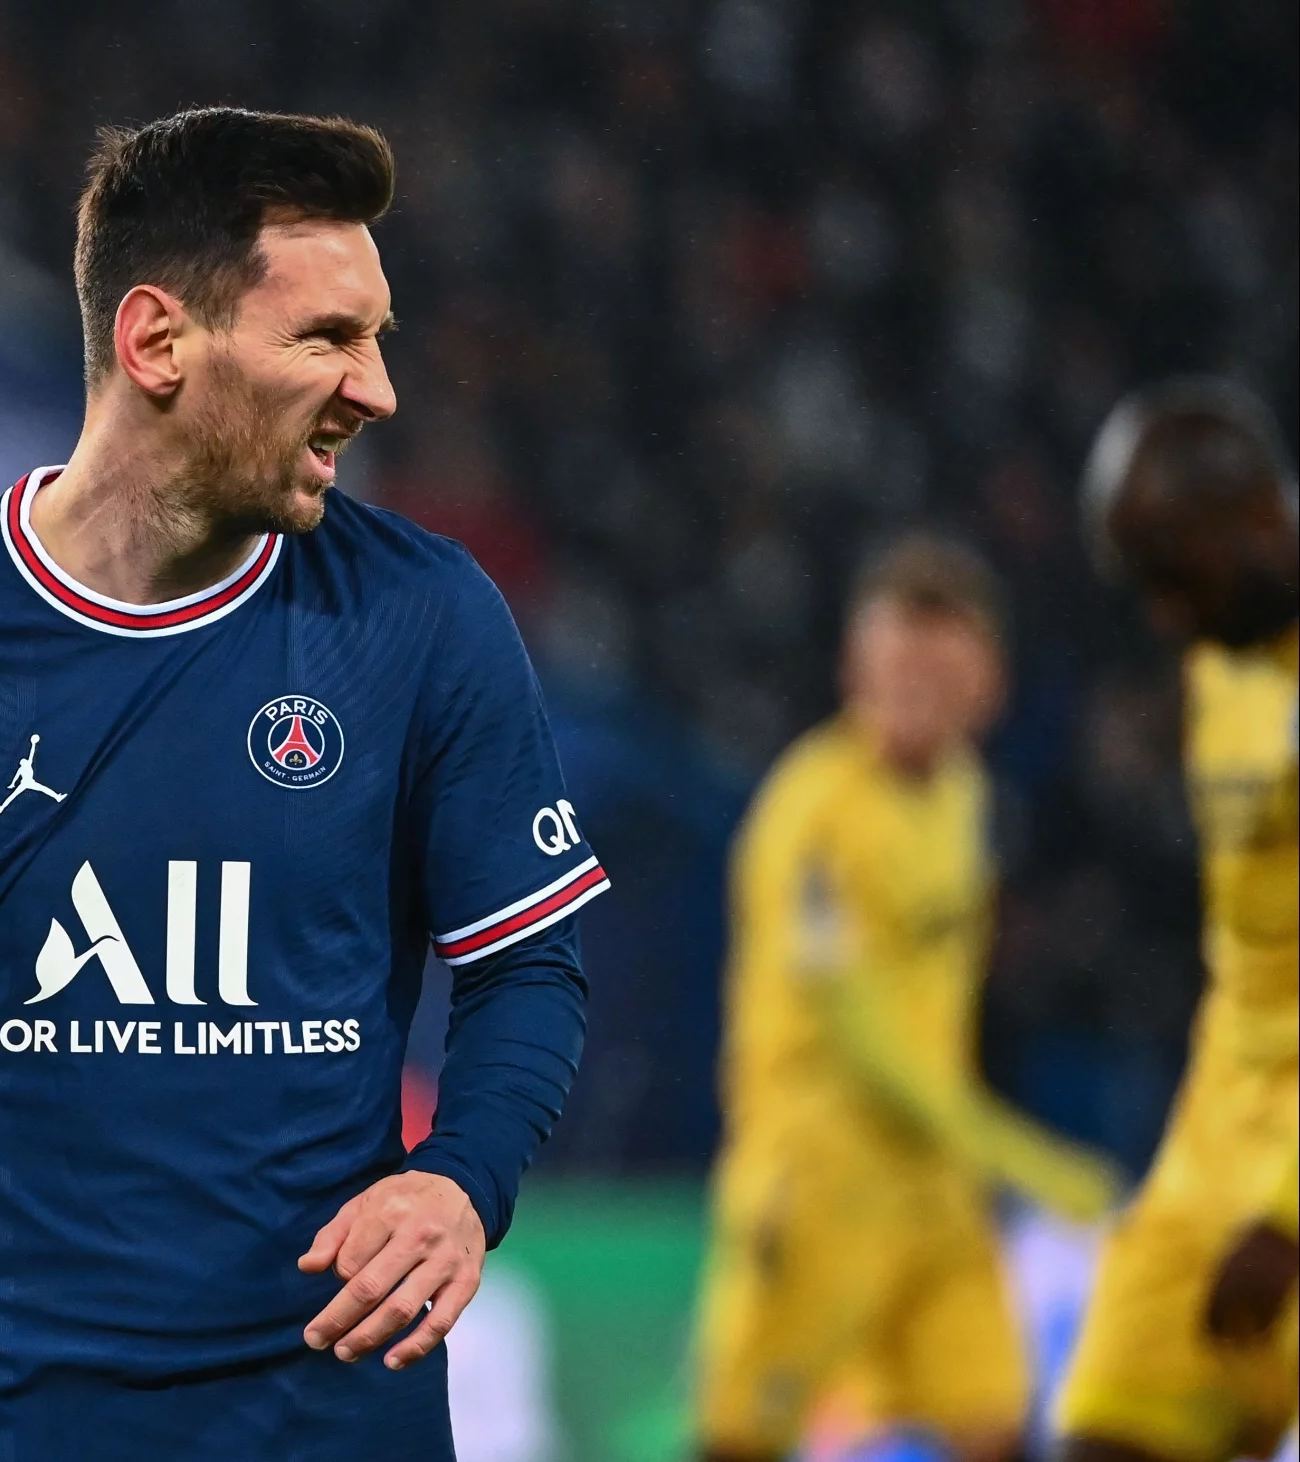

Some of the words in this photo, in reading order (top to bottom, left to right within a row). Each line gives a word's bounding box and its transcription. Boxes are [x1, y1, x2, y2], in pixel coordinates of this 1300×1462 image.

[264, 699, 329, 726] PARIS
[69, 1020, 162, 1054] LIVE
[173, 1018, 361, 1055] LIMITLESS
